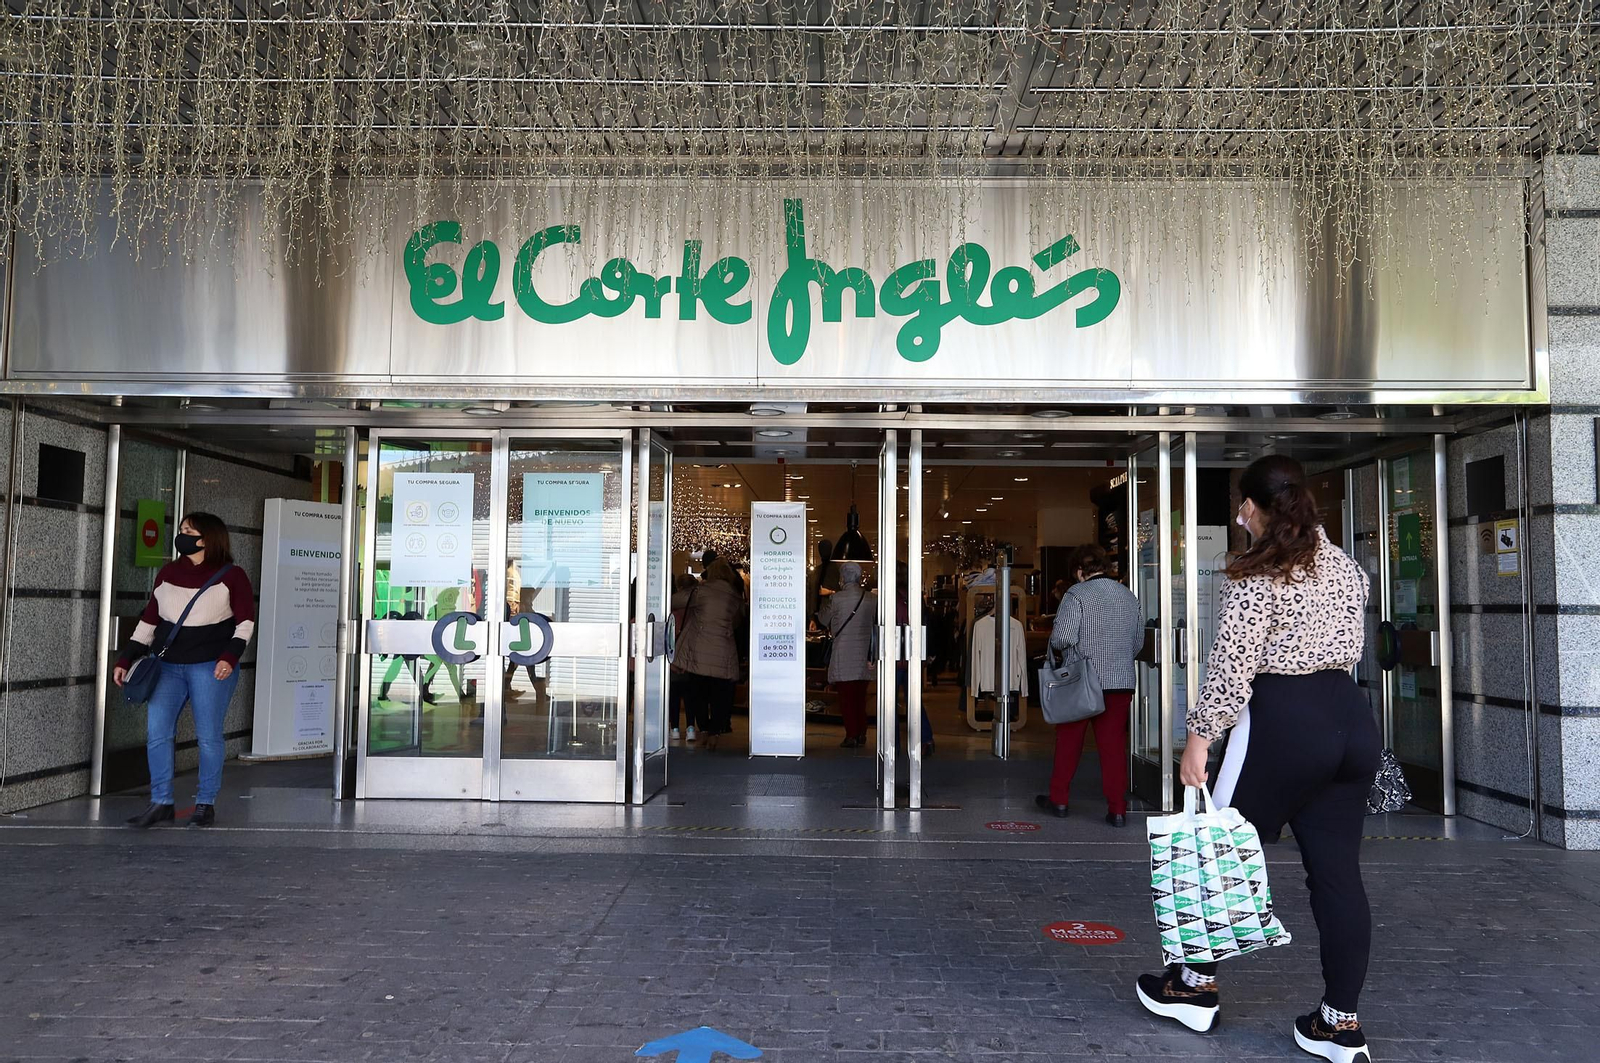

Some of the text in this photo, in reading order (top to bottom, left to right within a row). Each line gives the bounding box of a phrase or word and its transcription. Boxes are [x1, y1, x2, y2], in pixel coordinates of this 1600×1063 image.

[403, 197, 1122, 366] El Corte Inglés
[301, 511, 324, 519] COMPRA
[534, 509, 592, 517] BIENVENIDOS
[290, 549, 341, 559] BIENVENIDO
